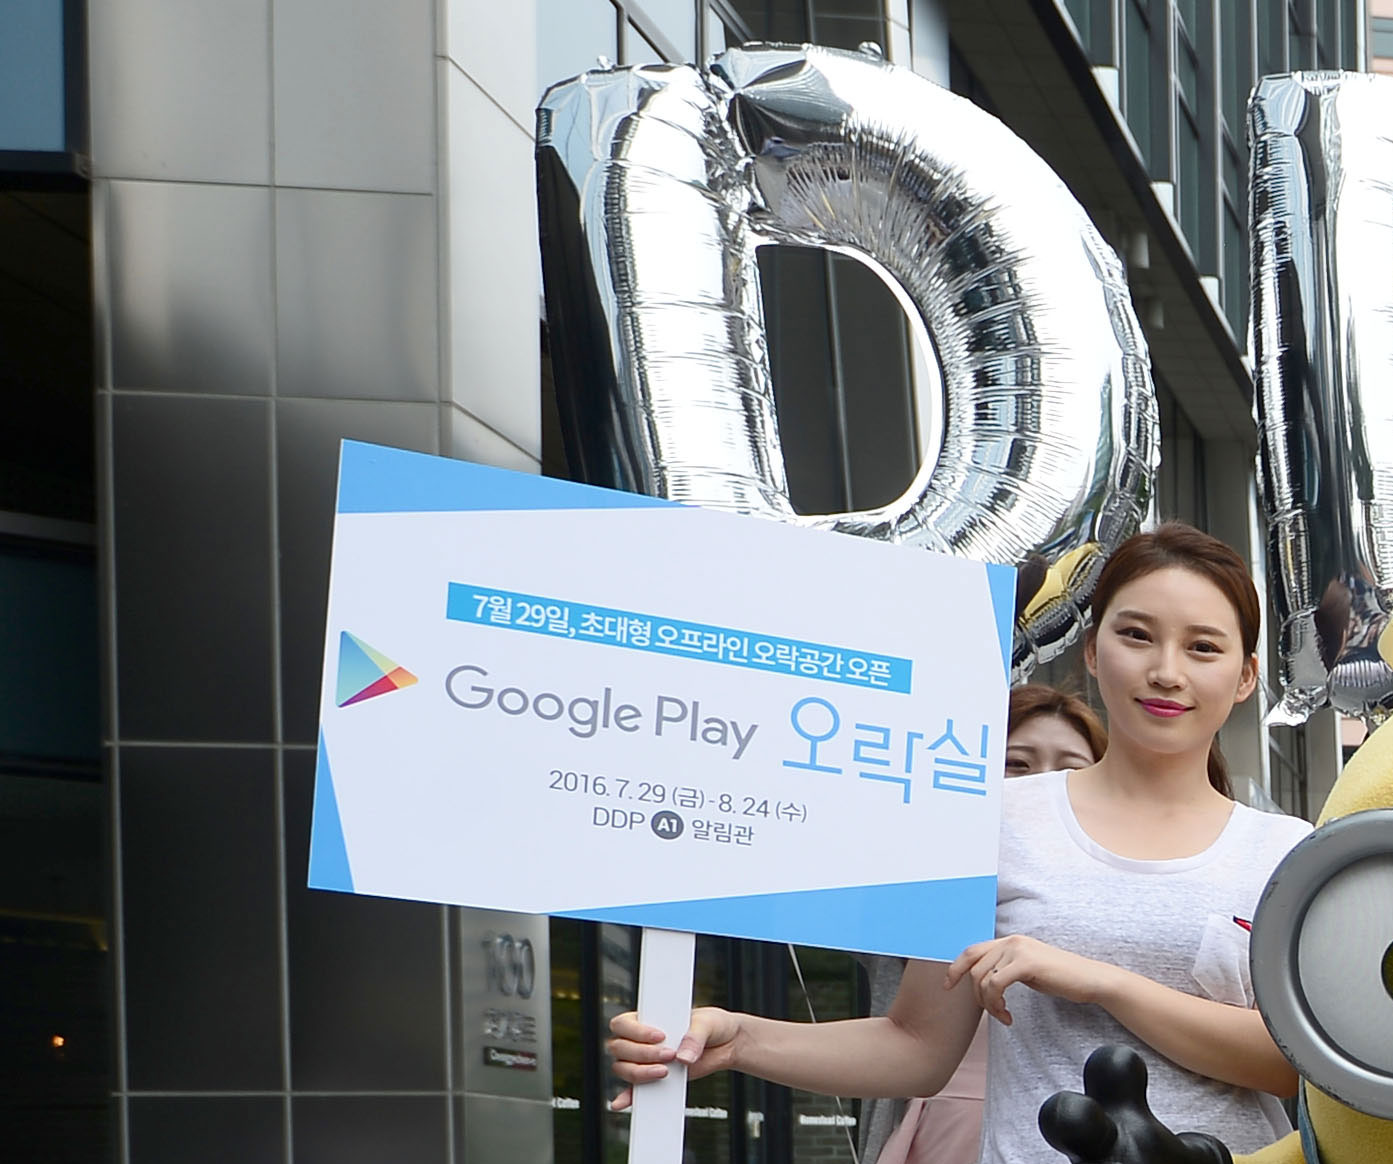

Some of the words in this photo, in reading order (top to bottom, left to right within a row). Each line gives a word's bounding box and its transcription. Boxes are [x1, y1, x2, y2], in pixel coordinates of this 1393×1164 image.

[472, 594, 513, 624] 7월
[515, 603, 577, 638] 29일,
[579, 610, 653, 648] 초대형
[654, 623, 750, 664] 오프라인
[752, 639, 844, 680] 오락공간
[845, 656, 892, 688] 오픈
[445, 664, 643, 739] Google
[655, 695, 759, 760] Play
[781, 696, 989, 805] 오락실
[593, 806, 646, 831] DDP
[655, 816, 679, 833] A1
[692, 819, 755, 847] 알림관
[775, 800, 807, 823] (수)
